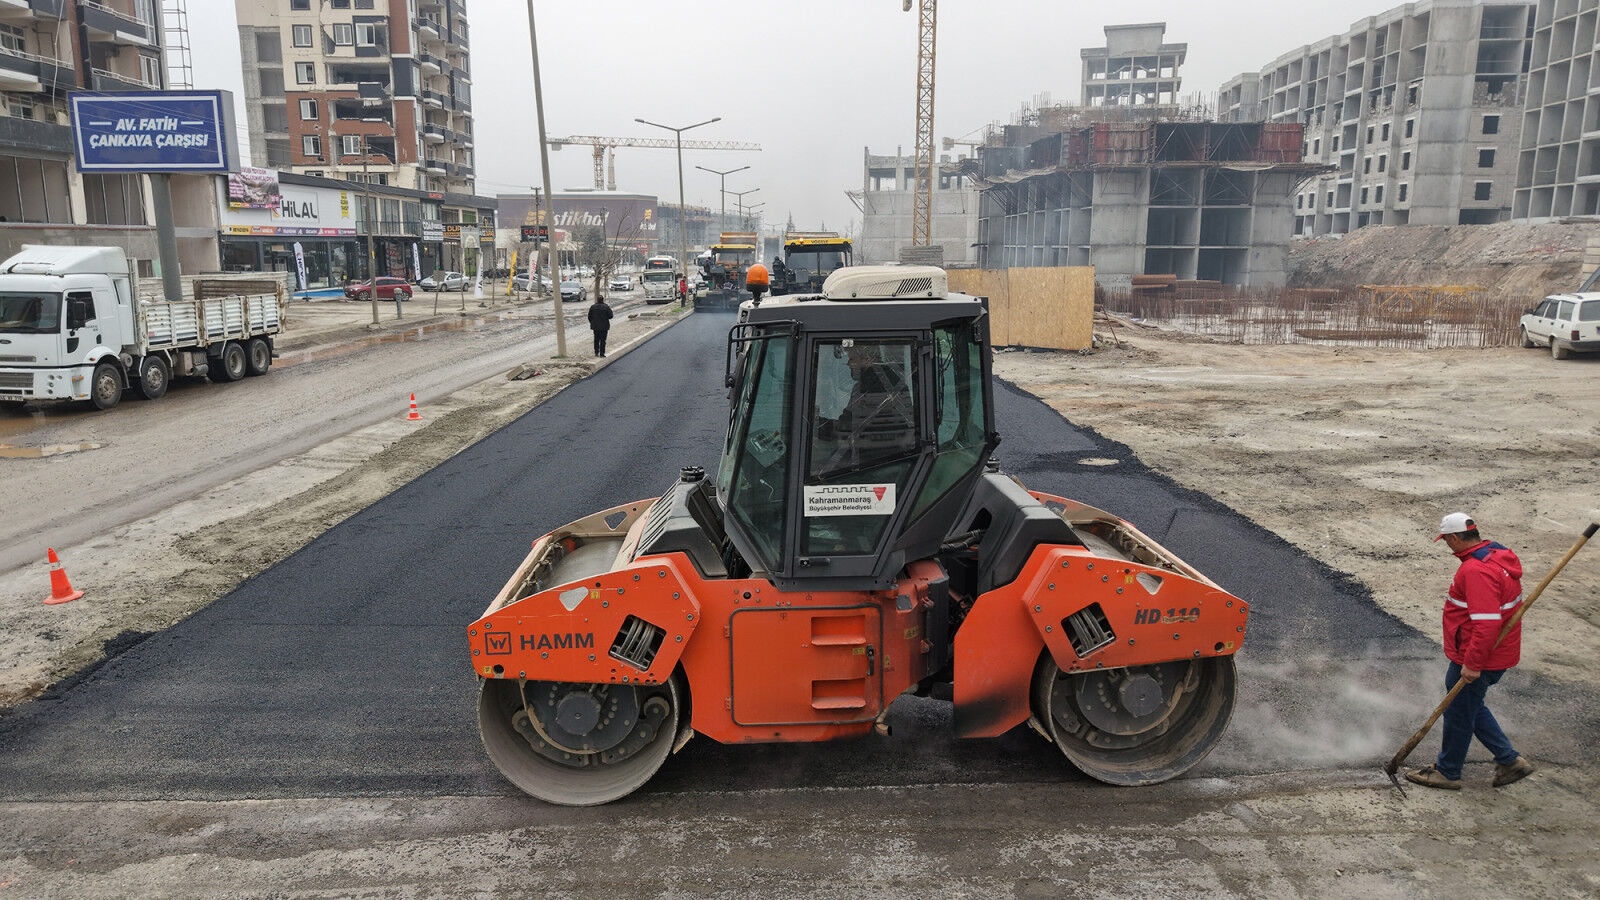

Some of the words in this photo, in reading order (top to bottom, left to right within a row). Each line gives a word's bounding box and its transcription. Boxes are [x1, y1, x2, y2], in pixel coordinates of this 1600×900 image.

[115, 118, 136, 131] AV.
[139, 116, 178, 131] FATİH
[89, 134, 153, 149] ÇANKAYA
[155, 134, 209, 149] ÇARŞISI
[808, 496, 872, 504] Kahramanmaraş
[1134, 608, 1161, 624] HD
[520, 632, 594, 650] HAMM
